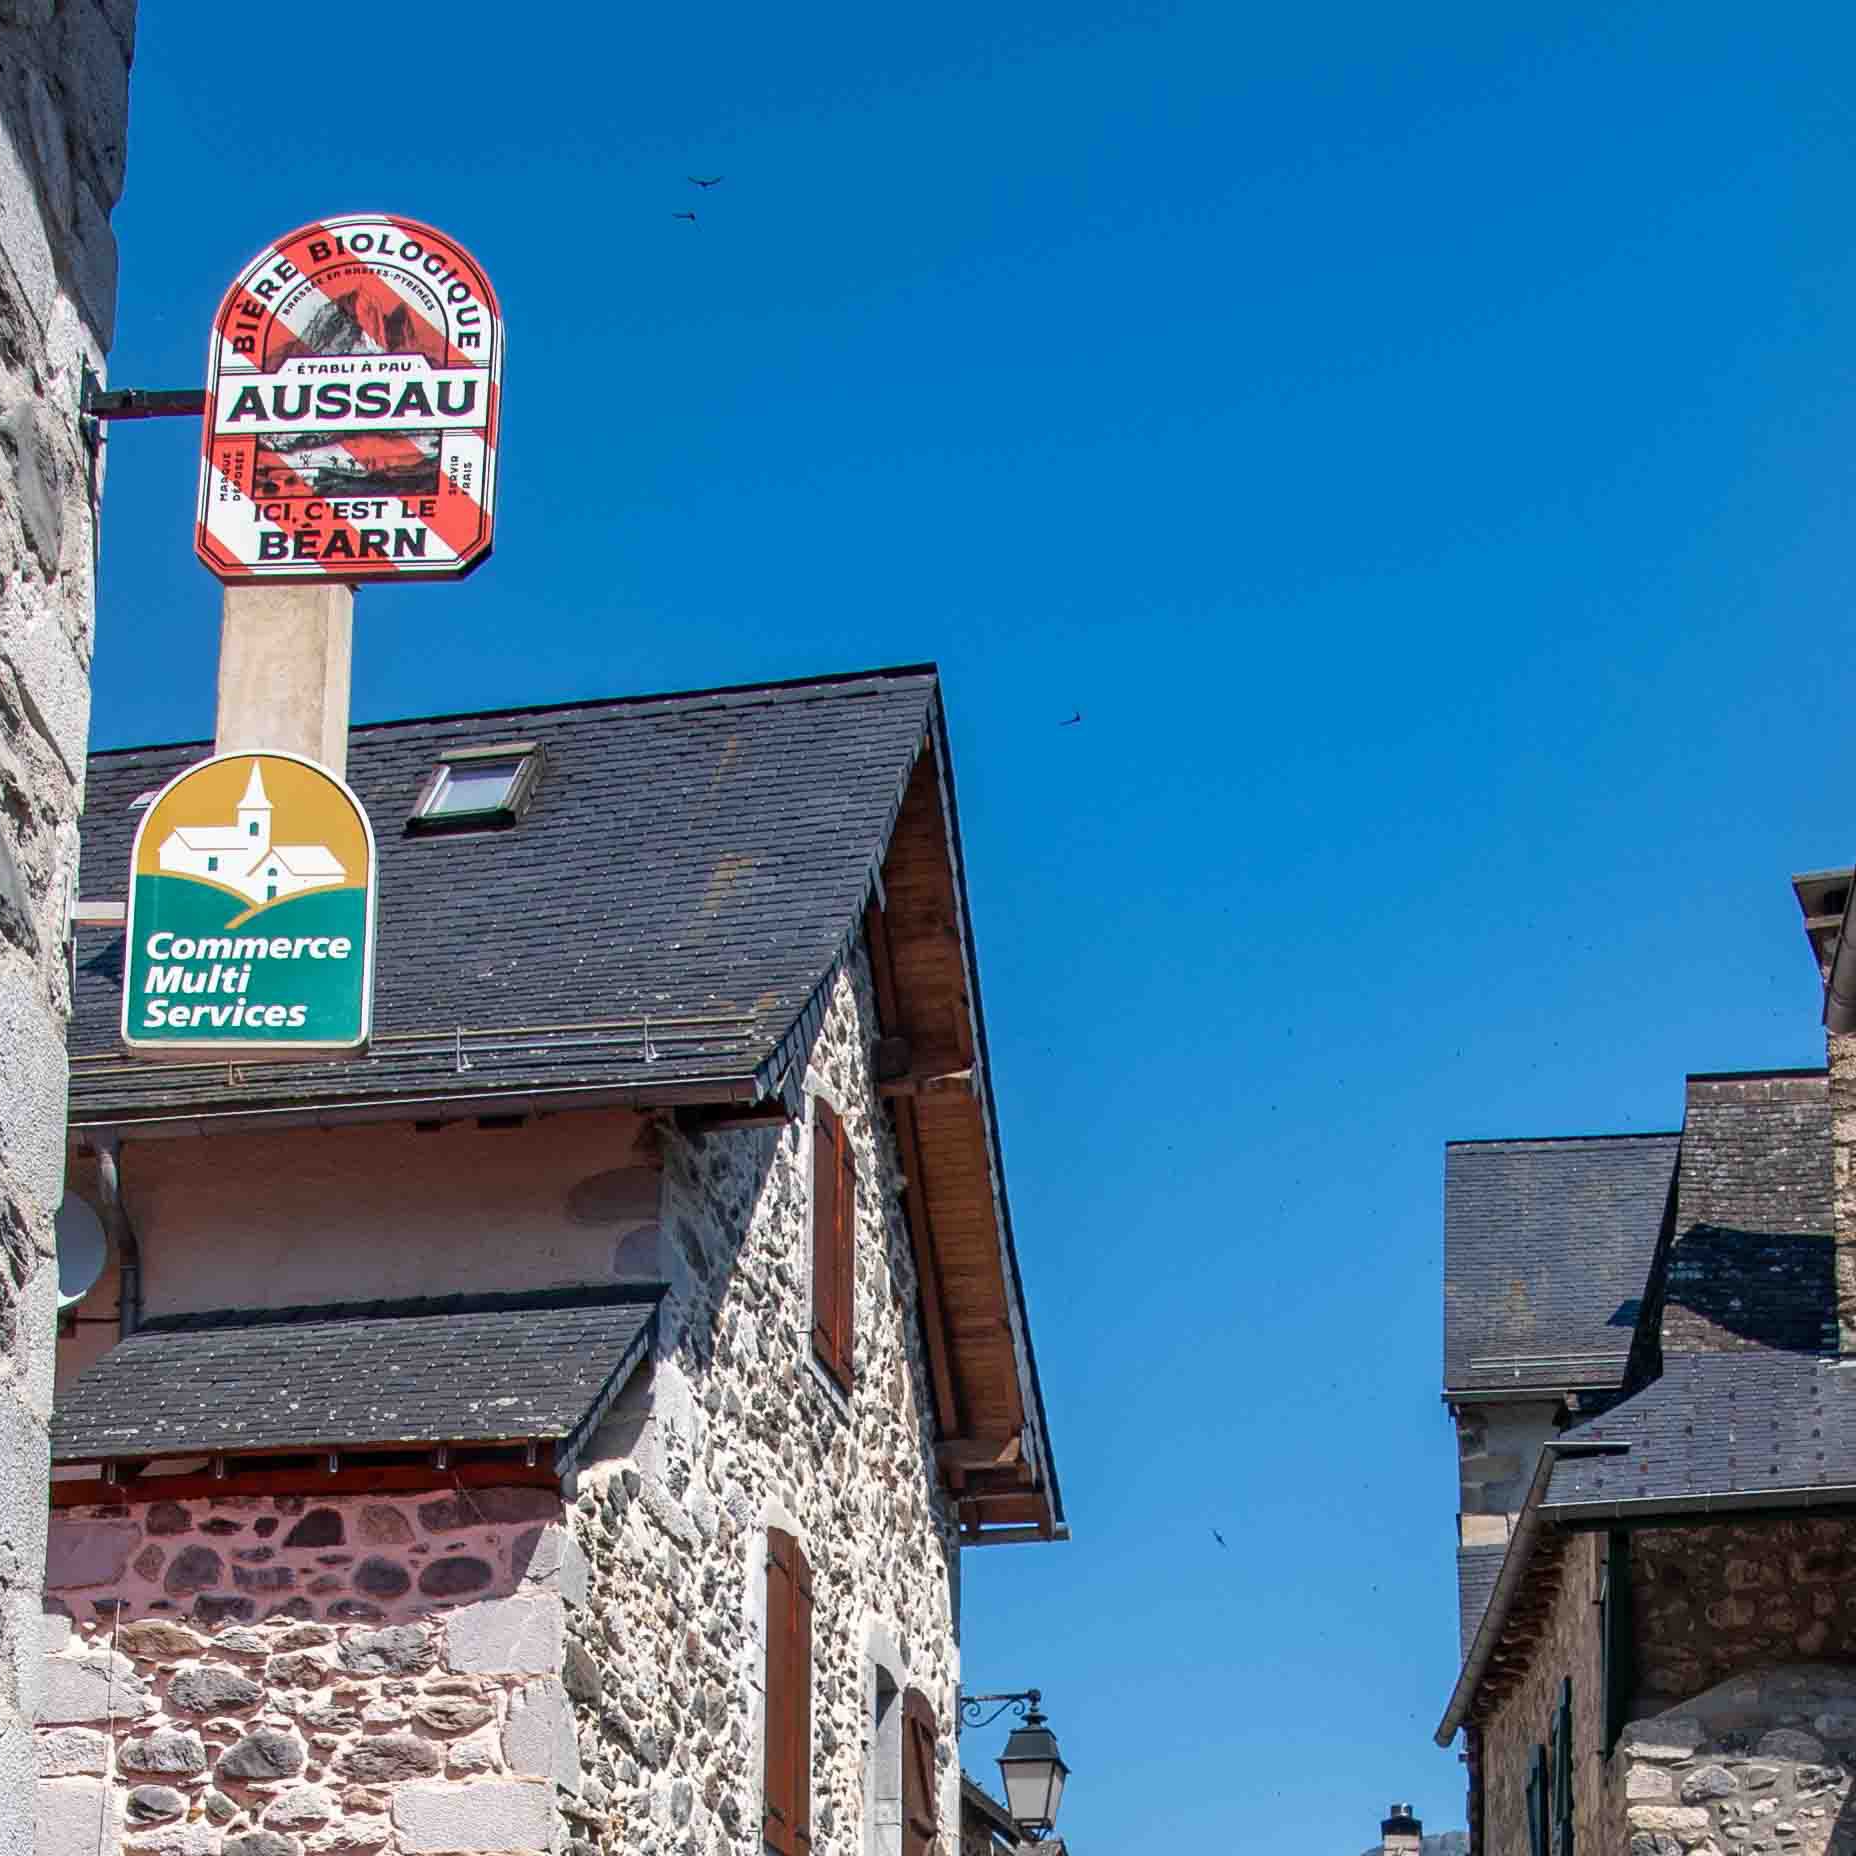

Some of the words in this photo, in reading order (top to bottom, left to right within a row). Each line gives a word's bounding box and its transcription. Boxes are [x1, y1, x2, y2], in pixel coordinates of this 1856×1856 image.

[232, 258, 298, 355] BIÈRE
[307, 233, 481, 349] BIOLOGIQUE
[297, 361, 355, 375] ÉTABLI
[361, 358, 378, 373] À
[381, 361, 411, 373] PAU
[226, 379, 479, 423] AUSSAU
[219, 450, 232, 502] MARQUE
[448, 455, 460, 497] SERVIR
[461, 461, 473, 496] FRAIS
[254, 503, 296, 523] ICI,
[304, 501, 389, 520] C'EST
[401, 499, 437, 518] LE
[257, 522, 427, 561] BÉARN
[146, 931, 352, 960] Commerce
[144, 964, 252, 994] Multi
[143, 998, 308, 1028] Services
